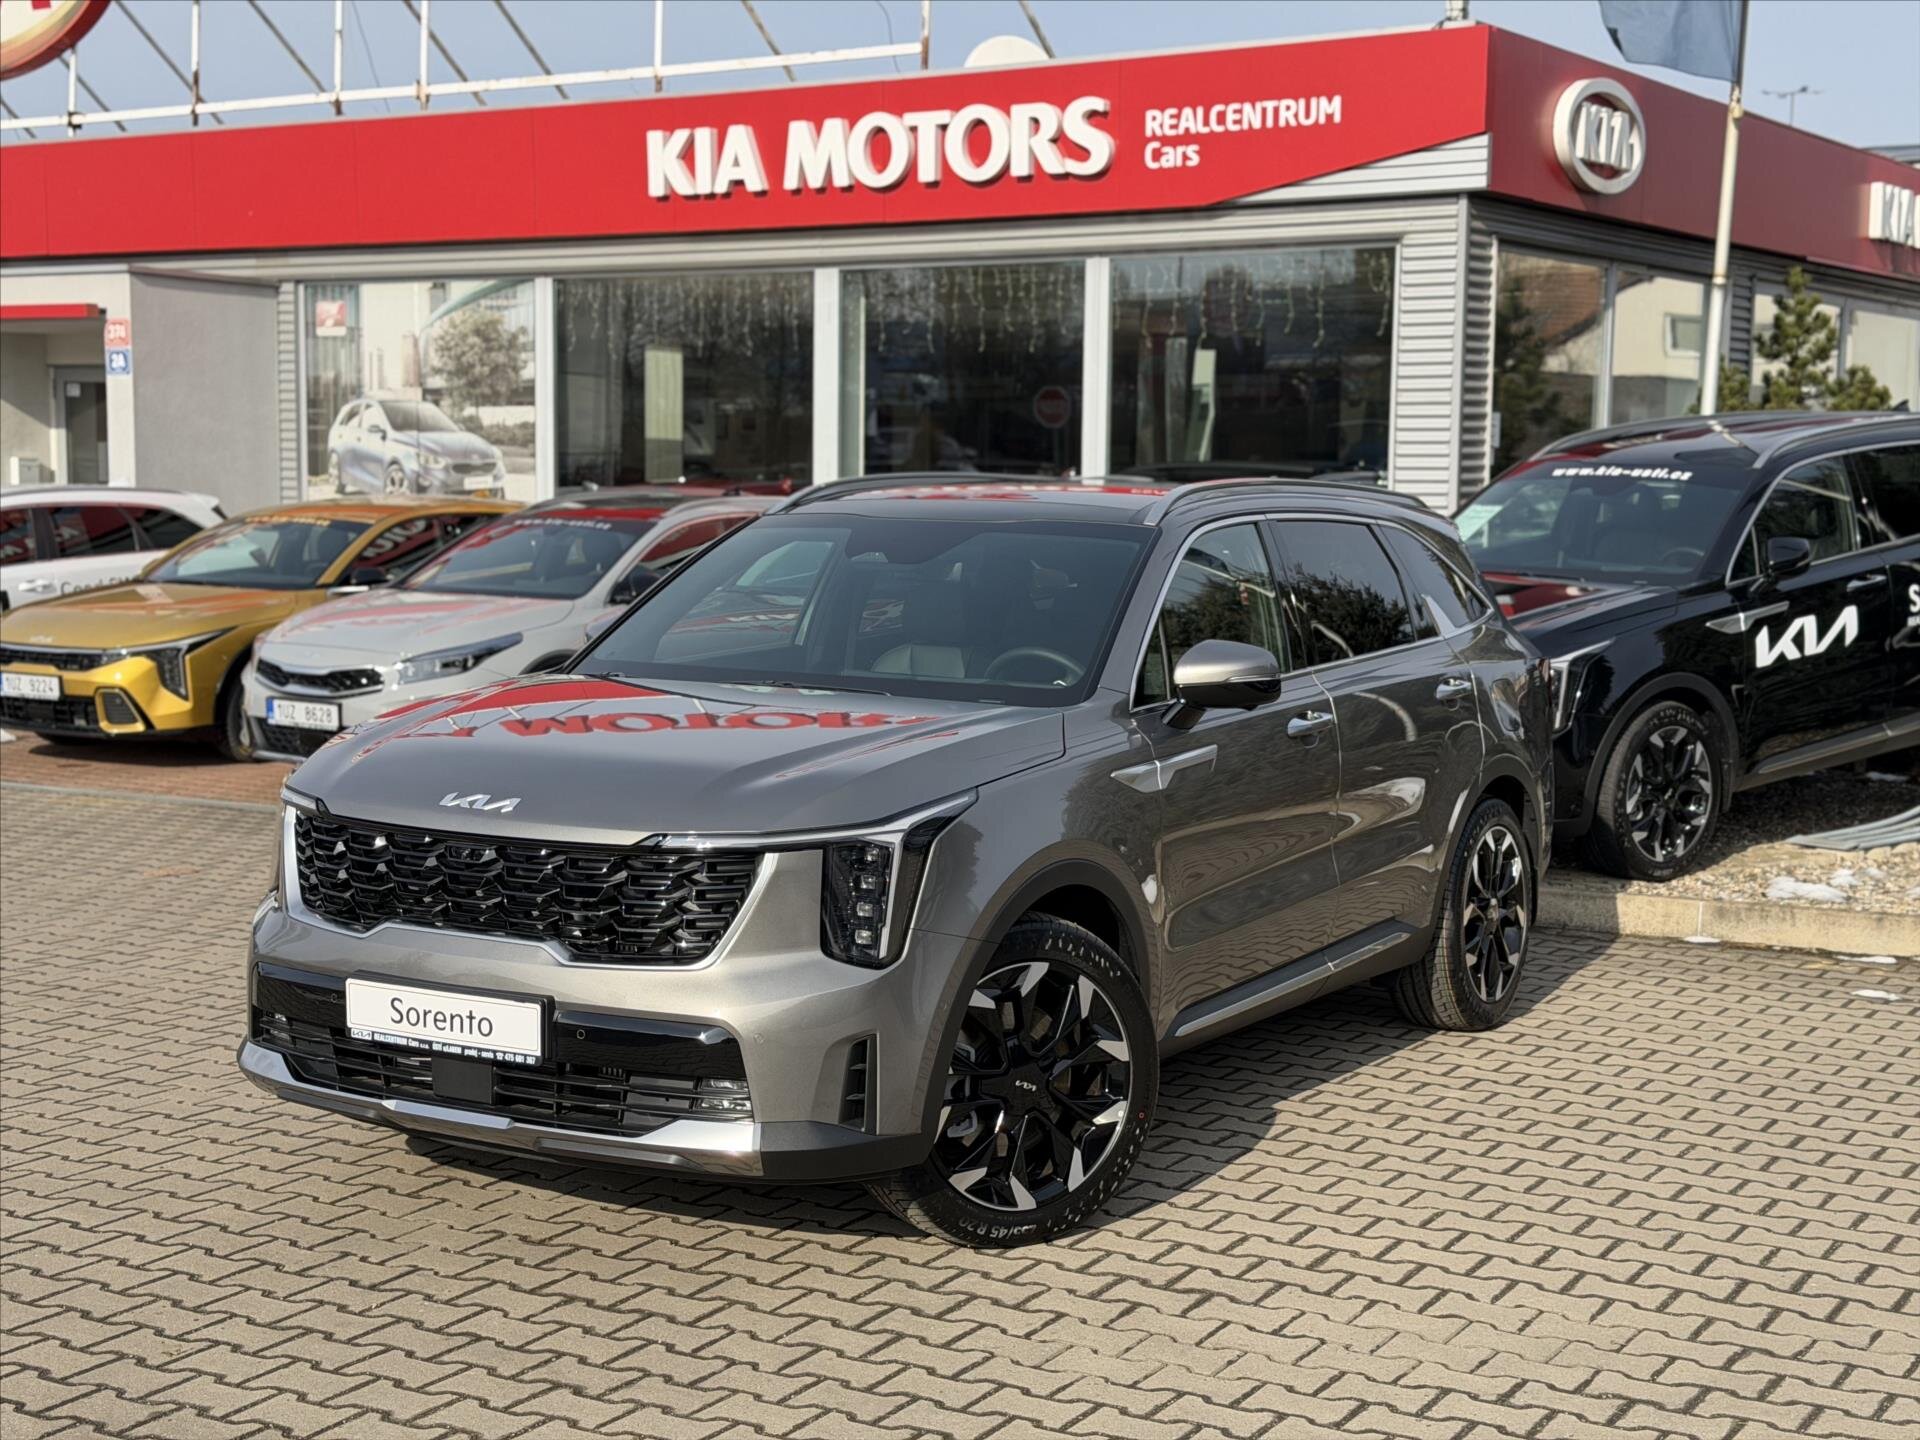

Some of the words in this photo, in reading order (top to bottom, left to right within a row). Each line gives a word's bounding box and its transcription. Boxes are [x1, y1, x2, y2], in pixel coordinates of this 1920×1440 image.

[1145, 95, 1342, 138] REALCENTRUM
[1575, 101, 1641, 171] KIA
[646, 124, 768, 197] KIA
[783, 96, 1114, 189] MOTORS
[1144, 141, 1200, 169] Cars
[1755, 604, 1860, 668] KIA
[390, 997, 493, 1037] Sorento
